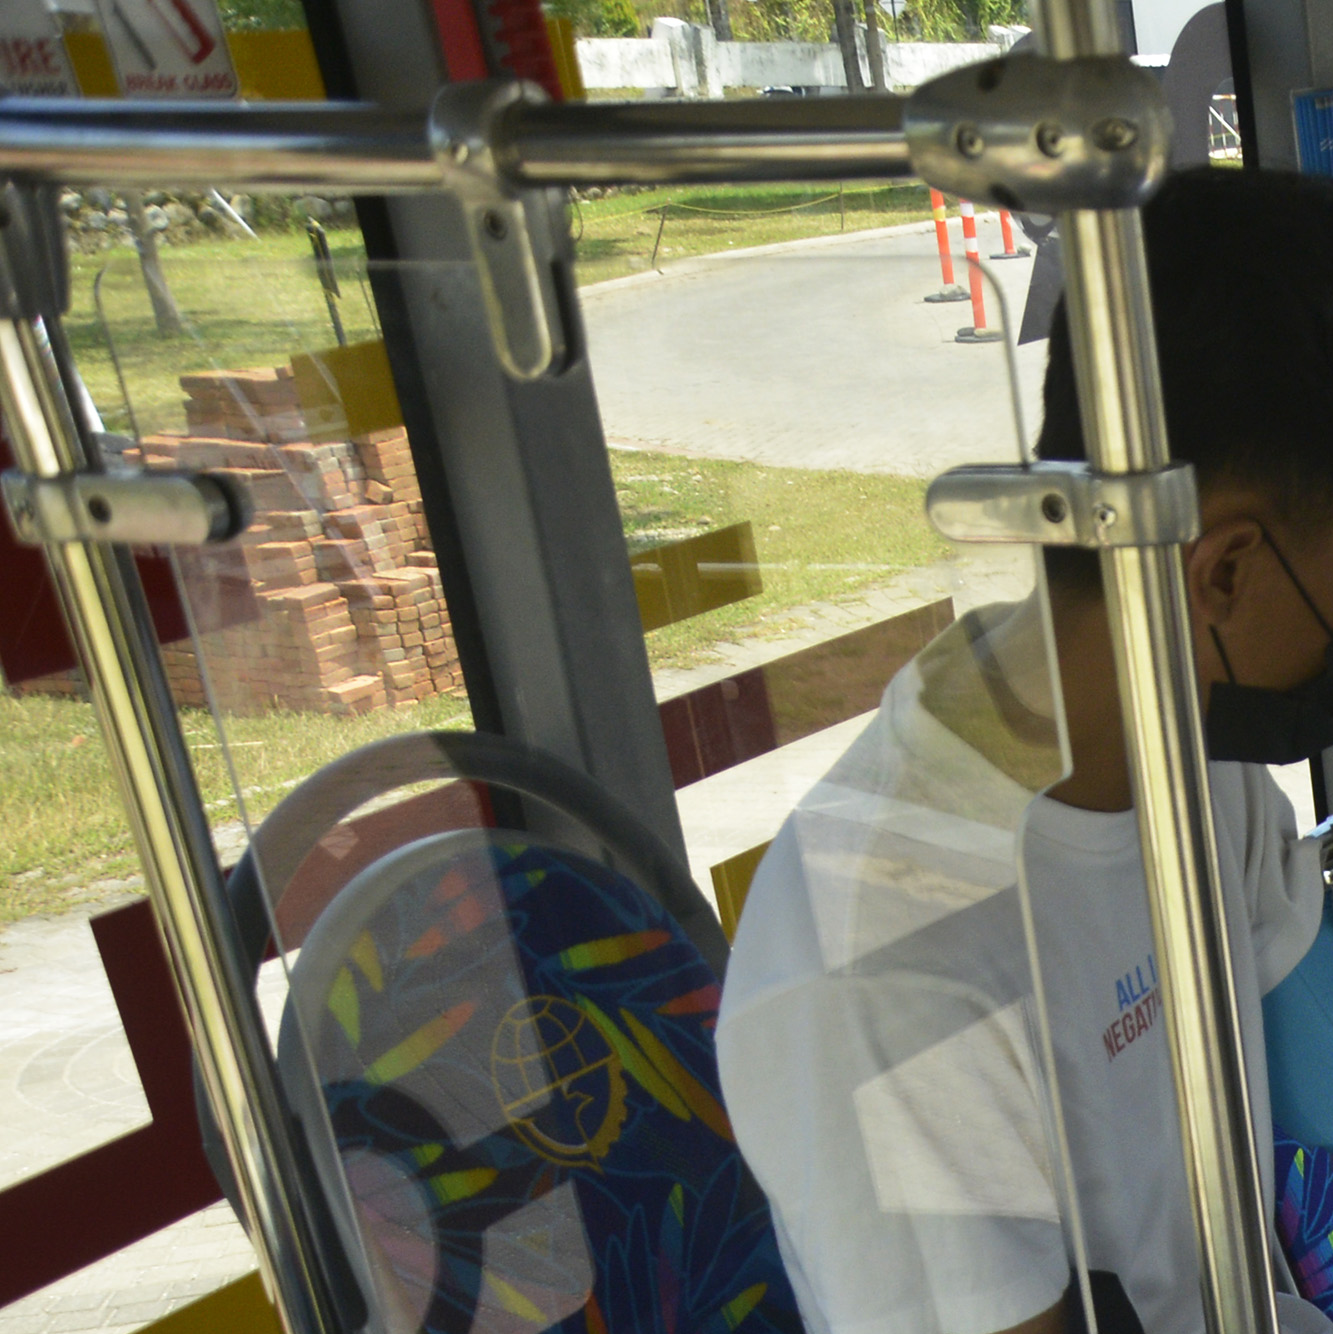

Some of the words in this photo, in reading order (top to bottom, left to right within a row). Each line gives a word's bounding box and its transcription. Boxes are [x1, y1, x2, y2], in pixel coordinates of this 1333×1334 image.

[0, 37, 61, 76] IRE
[125, 73, 178, 92] BREAK
[183, 73, 233, 91] GLASS
[1115, 965, 1150, 1012] ALL
